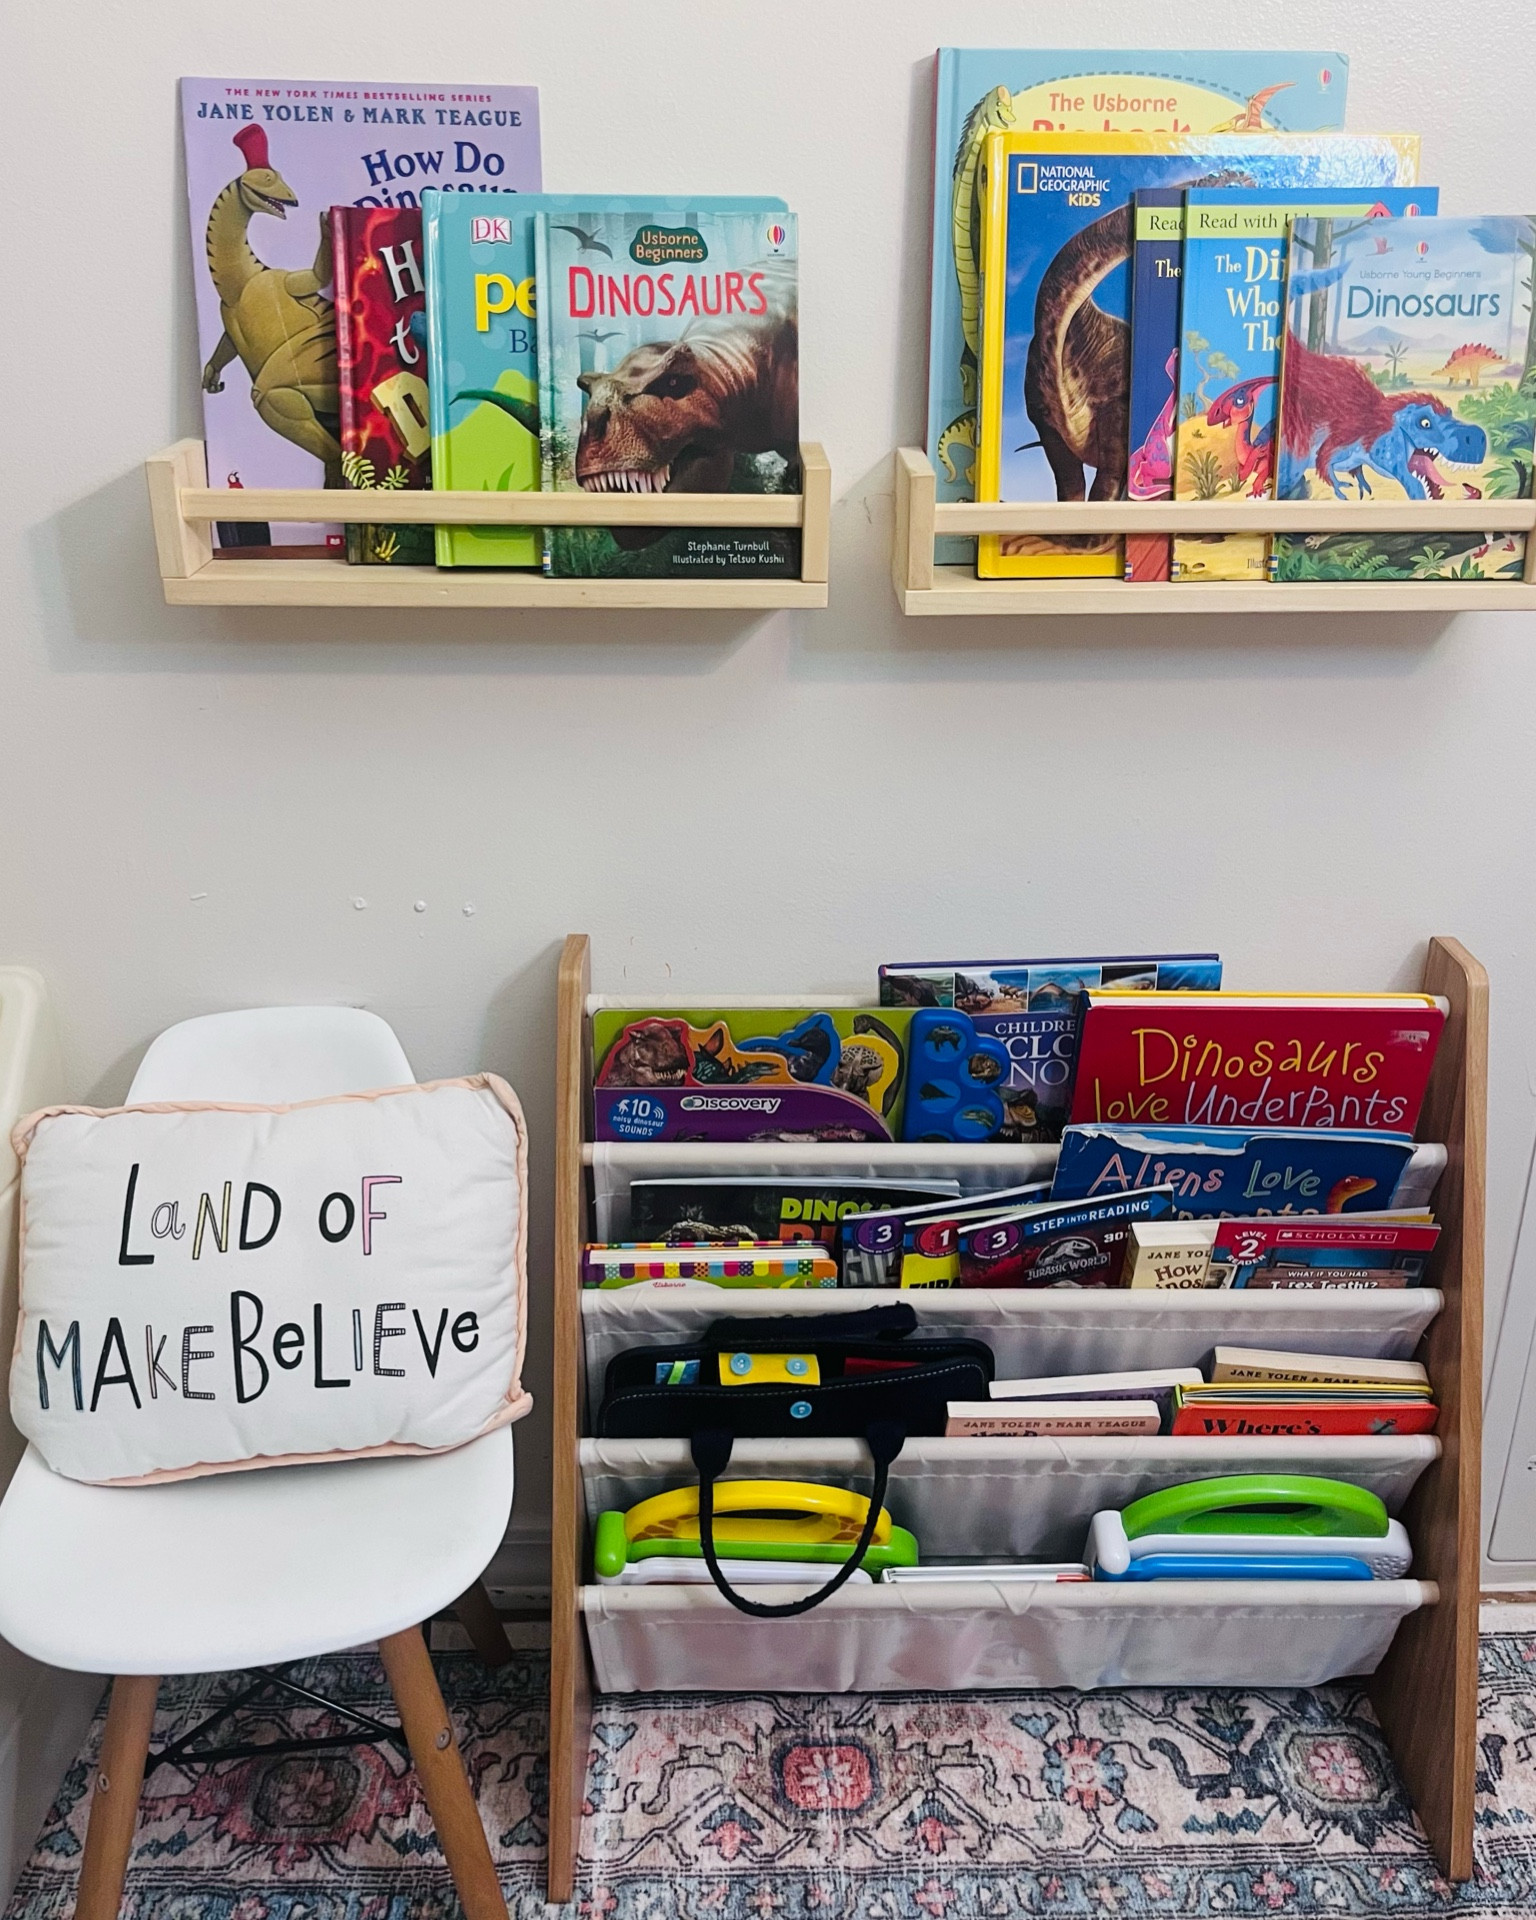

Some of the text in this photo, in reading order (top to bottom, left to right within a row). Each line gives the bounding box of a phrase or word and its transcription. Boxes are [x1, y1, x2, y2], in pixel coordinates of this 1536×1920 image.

[226, 88, 492, 103] THE NEW YORK TIMES BESTSELLING SERIES
[1049, 93, 1177, 112] The Usborne
[197, 102, 522, 127] JANE YOLEN & MARK TEAGUE
[453, 140, 505, 177] Do
[1040, 166, 1095, 178] NATIONAL
[1040, 179, 1110, 192] GEOGRAPHIC
[1200, 213, 1237, 229] Read
[1244, 213, 1277, 229] with
[474, 219, 508, 241] DK
[641, 231, 698, 246] Usborne
[636, 245, 703, 262] Beginners
[1214, 254, 1241, 273] The
[1360, 269, 1481, 281] Usborne Young Beginners
[1226, 285, 1279, 317] Who
[1347, 285, 1500, 319] Dinosaurs
[688, 541, 769, 554] Stephanie Turnbull
[673, 555, 713, 563] Illustrated
[716, 555, 726, 566] by
[728, 554, 756, 563] Tetsuo
[1132, 1028, 1385, 1086] Dinosaurs
[632, 1099, 650, 1117] 10
[613, 1116, 664, 1127] noisy dinosaur
[619, 1125, 653, 1136] SOUNDS
[1243, 1160, 1320, 1197] Love
[1033, 1201, 1150, 1233] STEP INTO READING
[876, 1225, 892, 1243] 3
[940, 1229, 950, 1246] 1
[992, 1230, 1007, 1249] 3
[1235, 1230, 1267, 1240] LEVEL
[1295, 1232, 1393, 1241] SCHOLASTIC
[1148, 1251, 1180, 1259] JANE
[1239, 1239, 1259, 1257] 2
[1027, 1256, 1108, 1280] JURASSIC WORLD
[1226, 1254, 1266, 1266] READER
[1231, 1369, 1262, 1378] JANE
[1267, 1372, 1308, 1382] YOLEN
[1097, 1420, 1146, 1428] TEAGUE
[1203, 1419, 1321, 1435] Where's
